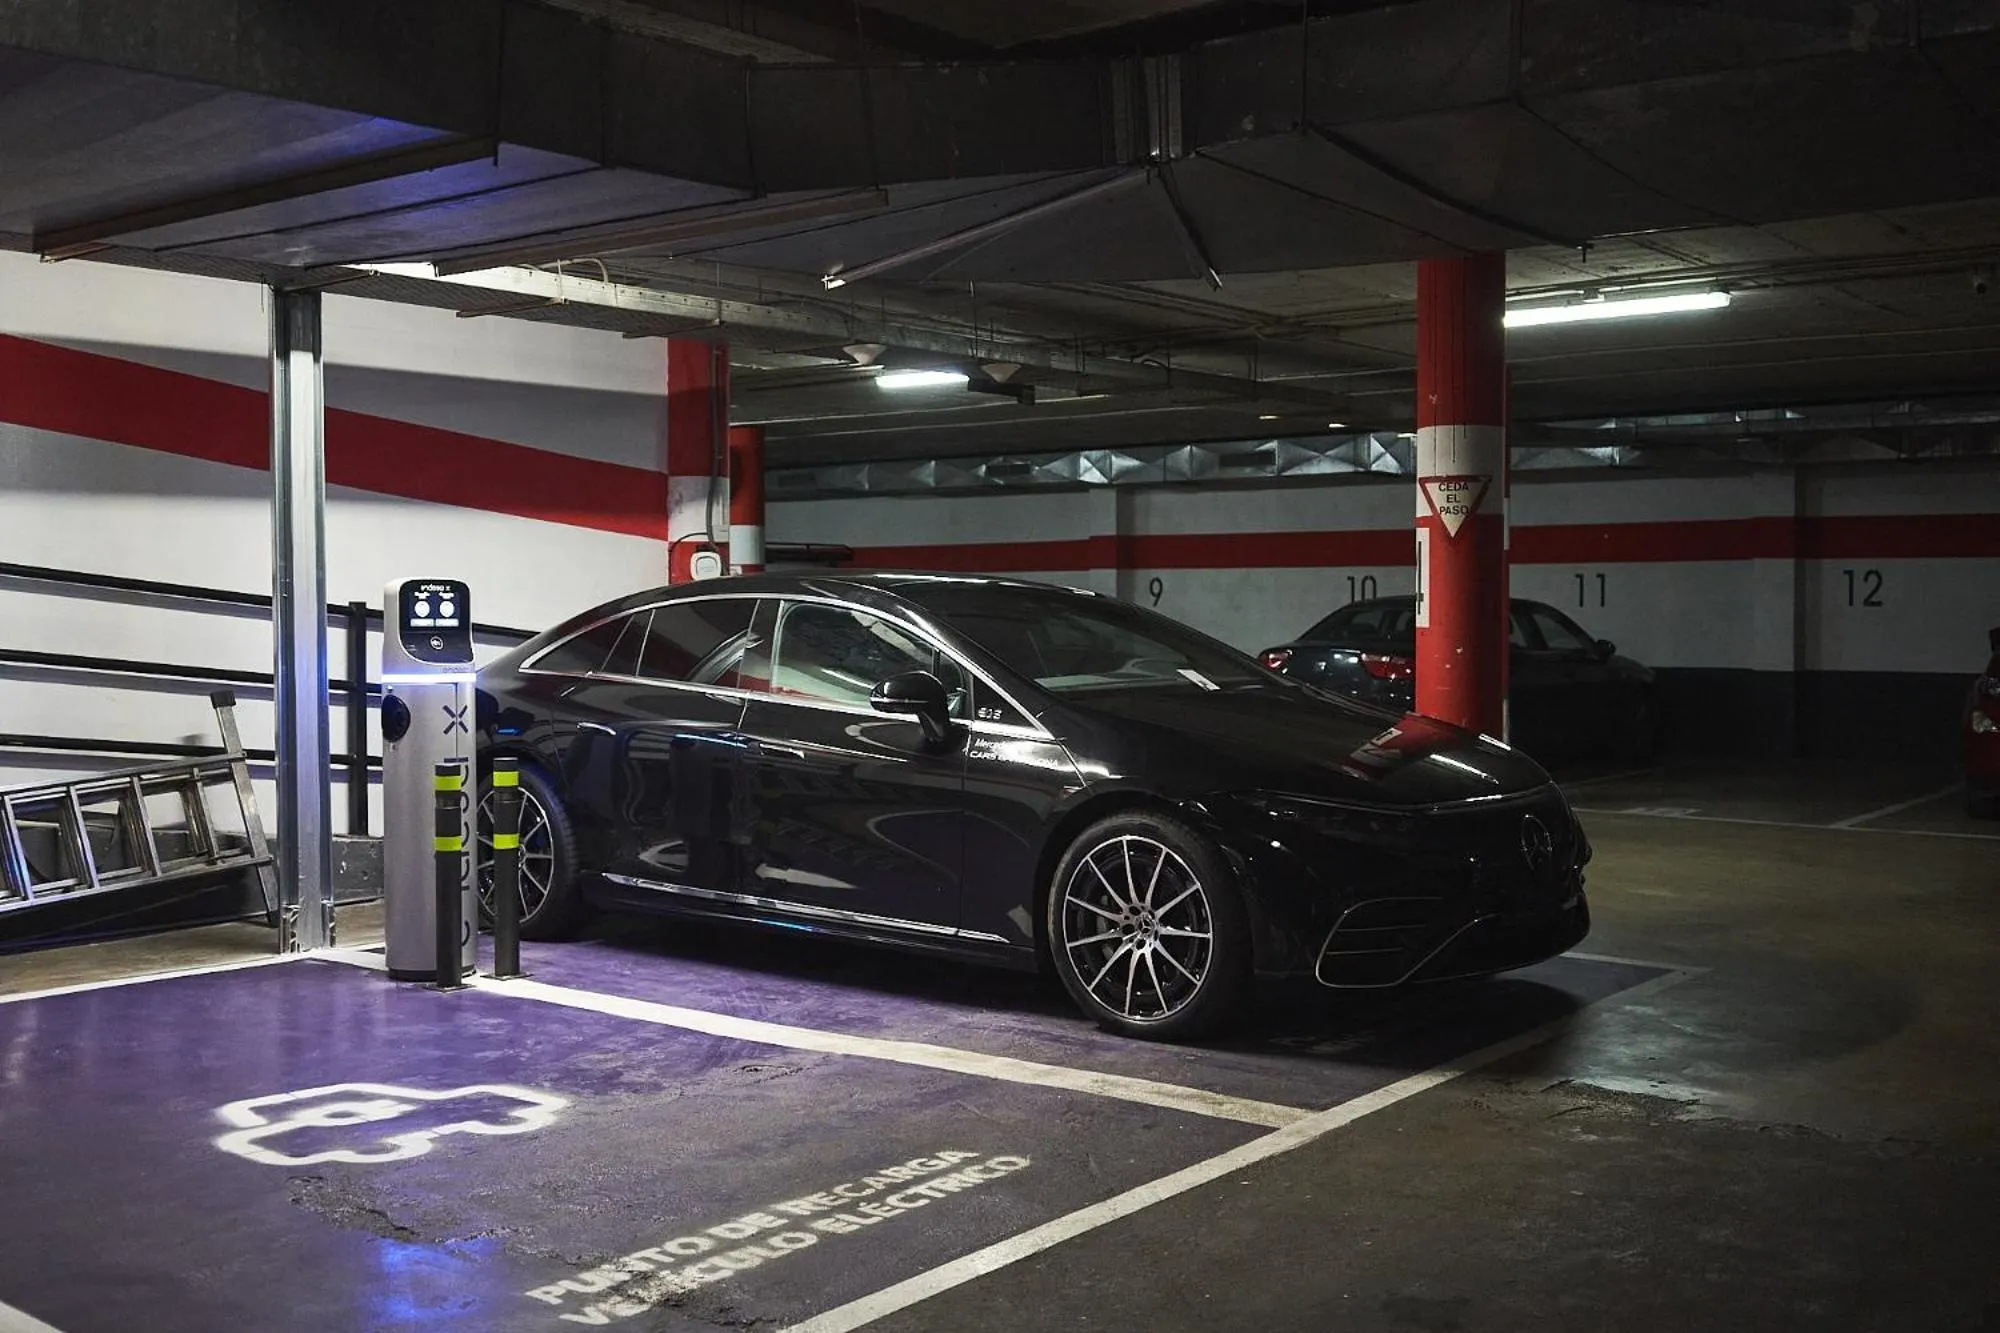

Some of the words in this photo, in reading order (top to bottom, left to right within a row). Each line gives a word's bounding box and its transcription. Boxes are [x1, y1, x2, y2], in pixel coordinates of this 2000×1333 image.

[1438, 482, 1469, 492] CEDA
[1446, 494, 1461, 503] EL
[1439, 506, 1470, 516] PASO
[1149, 577, 1163, 607] 9
[1347, 575, 1377, 601] 10
[1575, 573, 1605, 607] 11
[1843, 570, 1883, 606] 12
[705, 1212, 788, 1239] DE
[768, 1150, 979, 1215] RECARGA
[811, 1155, 1031, 1234] ELÉCTRICO
